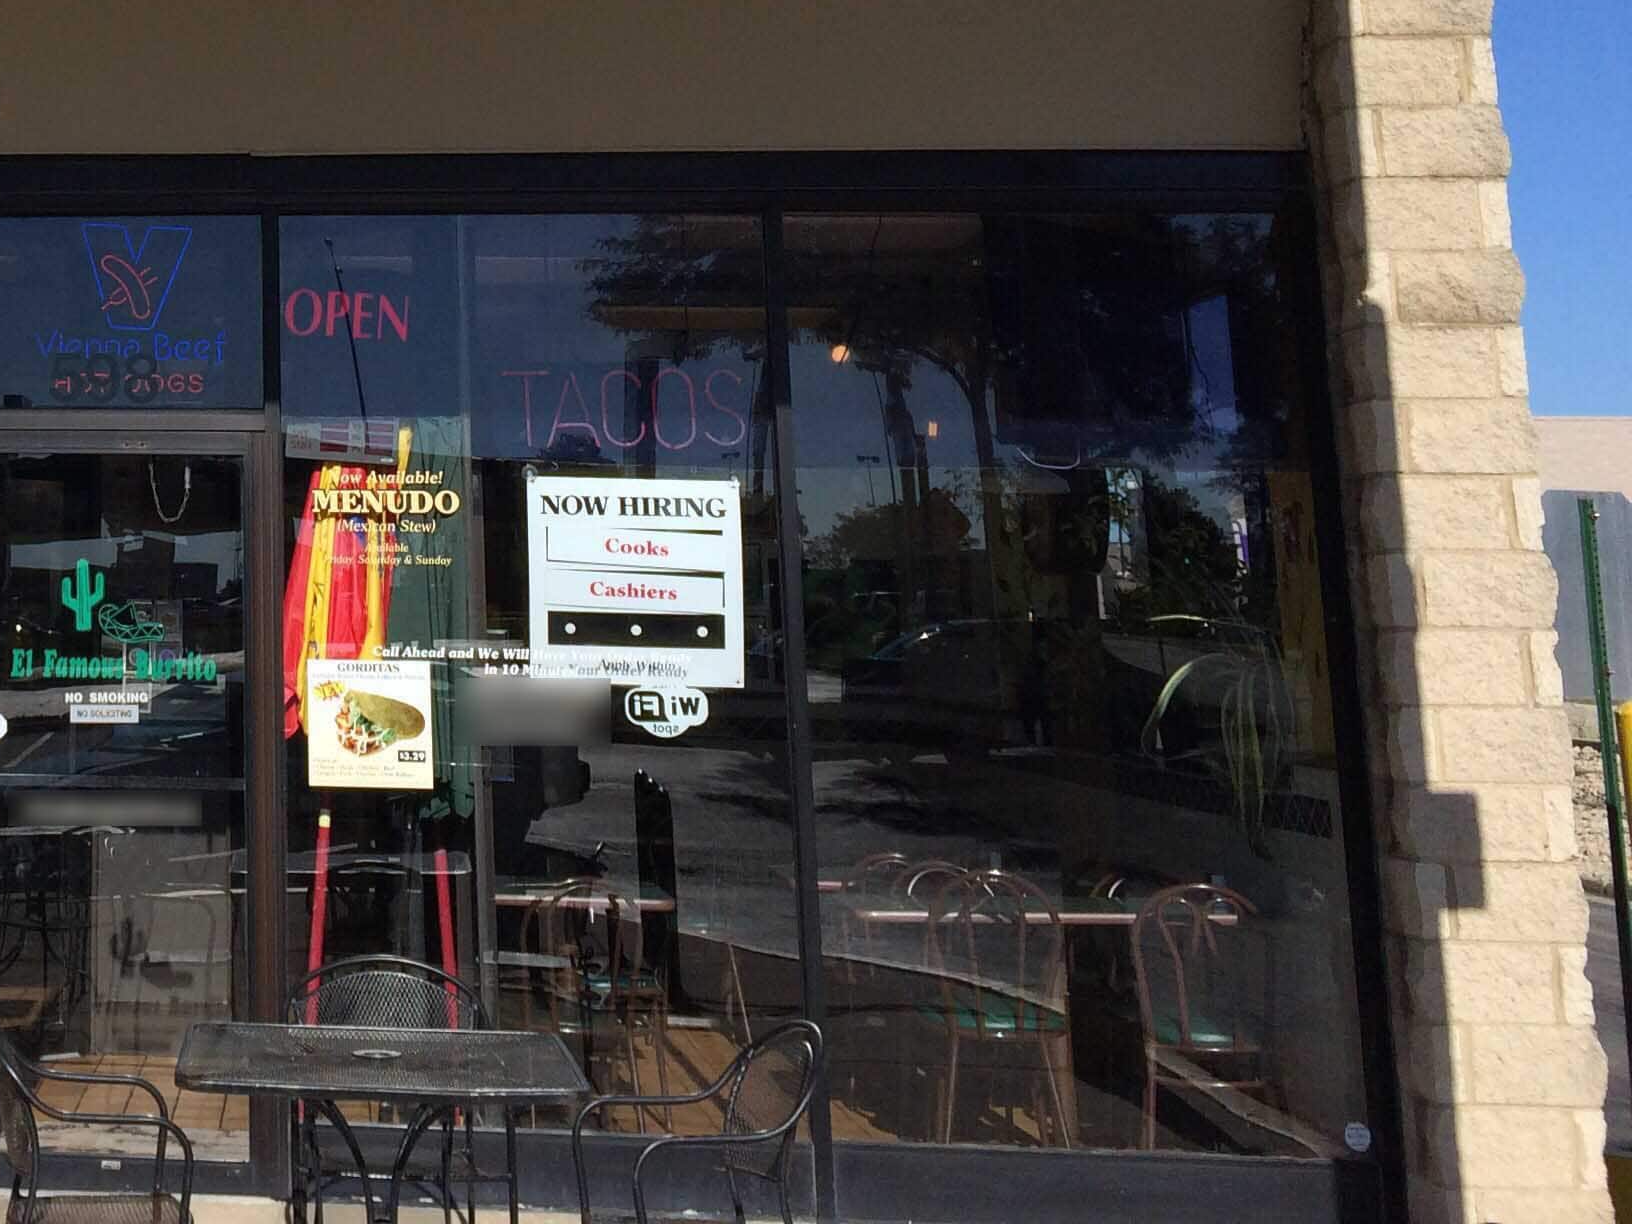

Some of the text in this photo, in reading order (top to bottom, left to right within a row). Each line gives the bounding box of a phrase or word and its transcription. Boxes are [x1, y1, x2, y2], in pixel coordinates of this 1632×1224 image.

[285, 287, 410, 343] OPEN
[34, 327, 228, 366] Vienna Beef
[502, 367, 747, 450] TACOS
[328, 469, 443, 485] Now Available!
[311, 490, 460, 514] MENUDO
[540, 495, 727, 518] NOW HIRING
[400, 519, 436, 533] Stew)
[604, 537, 669, 557] Cooks
[404, 556, 413, 565] &
[416, 555, 452, 567] Sunday
[589, 580, 678, 601] Cashiers
[373, 645, 399, 657] Call
[402, 645, 446, 658] Ahead
[448, 647, 474, 659] and
[478, 647, 499, 660] We
[503, 648, 530, 660] Will
[11, 648, 217, 681] El Famous Burrito
[337, 663, 400, 673] GORDITAS
[484, 663, 497, 675] in
[502, 664, 519, 675] 10
[65, 692, 149, 704] NO SMOKING
[77, 710, 88, 719] NO
